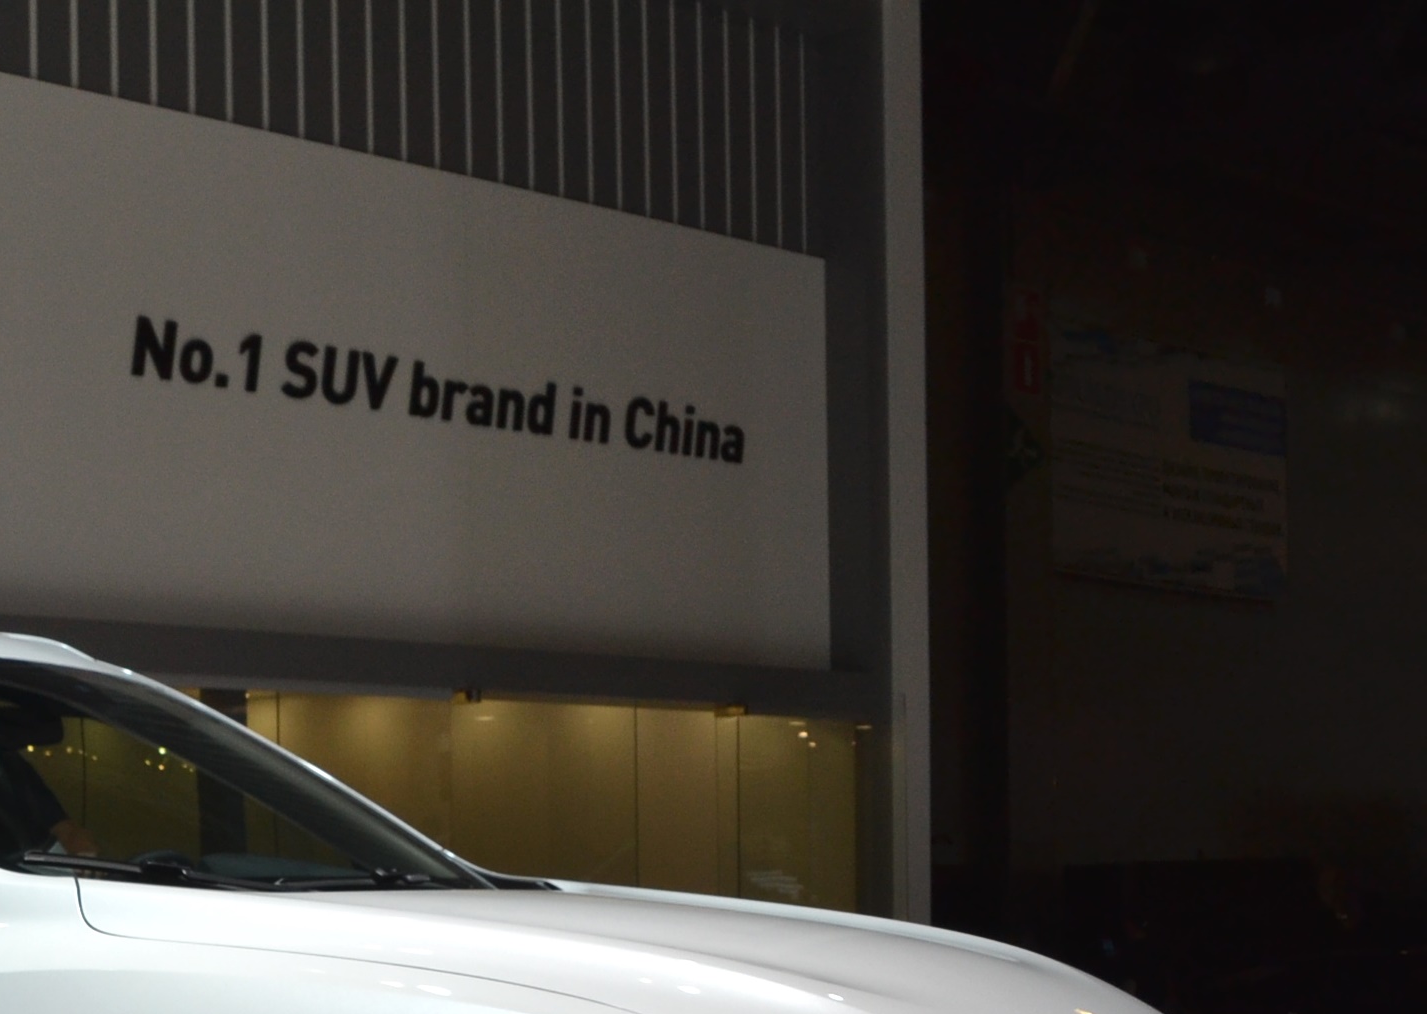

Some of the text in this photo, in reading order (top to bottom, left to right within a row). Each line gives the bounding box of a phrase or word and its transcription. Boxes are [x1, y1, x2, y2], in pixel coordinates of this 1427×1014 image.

[131, 314, 746, 466] No.1 SUV brand in China
